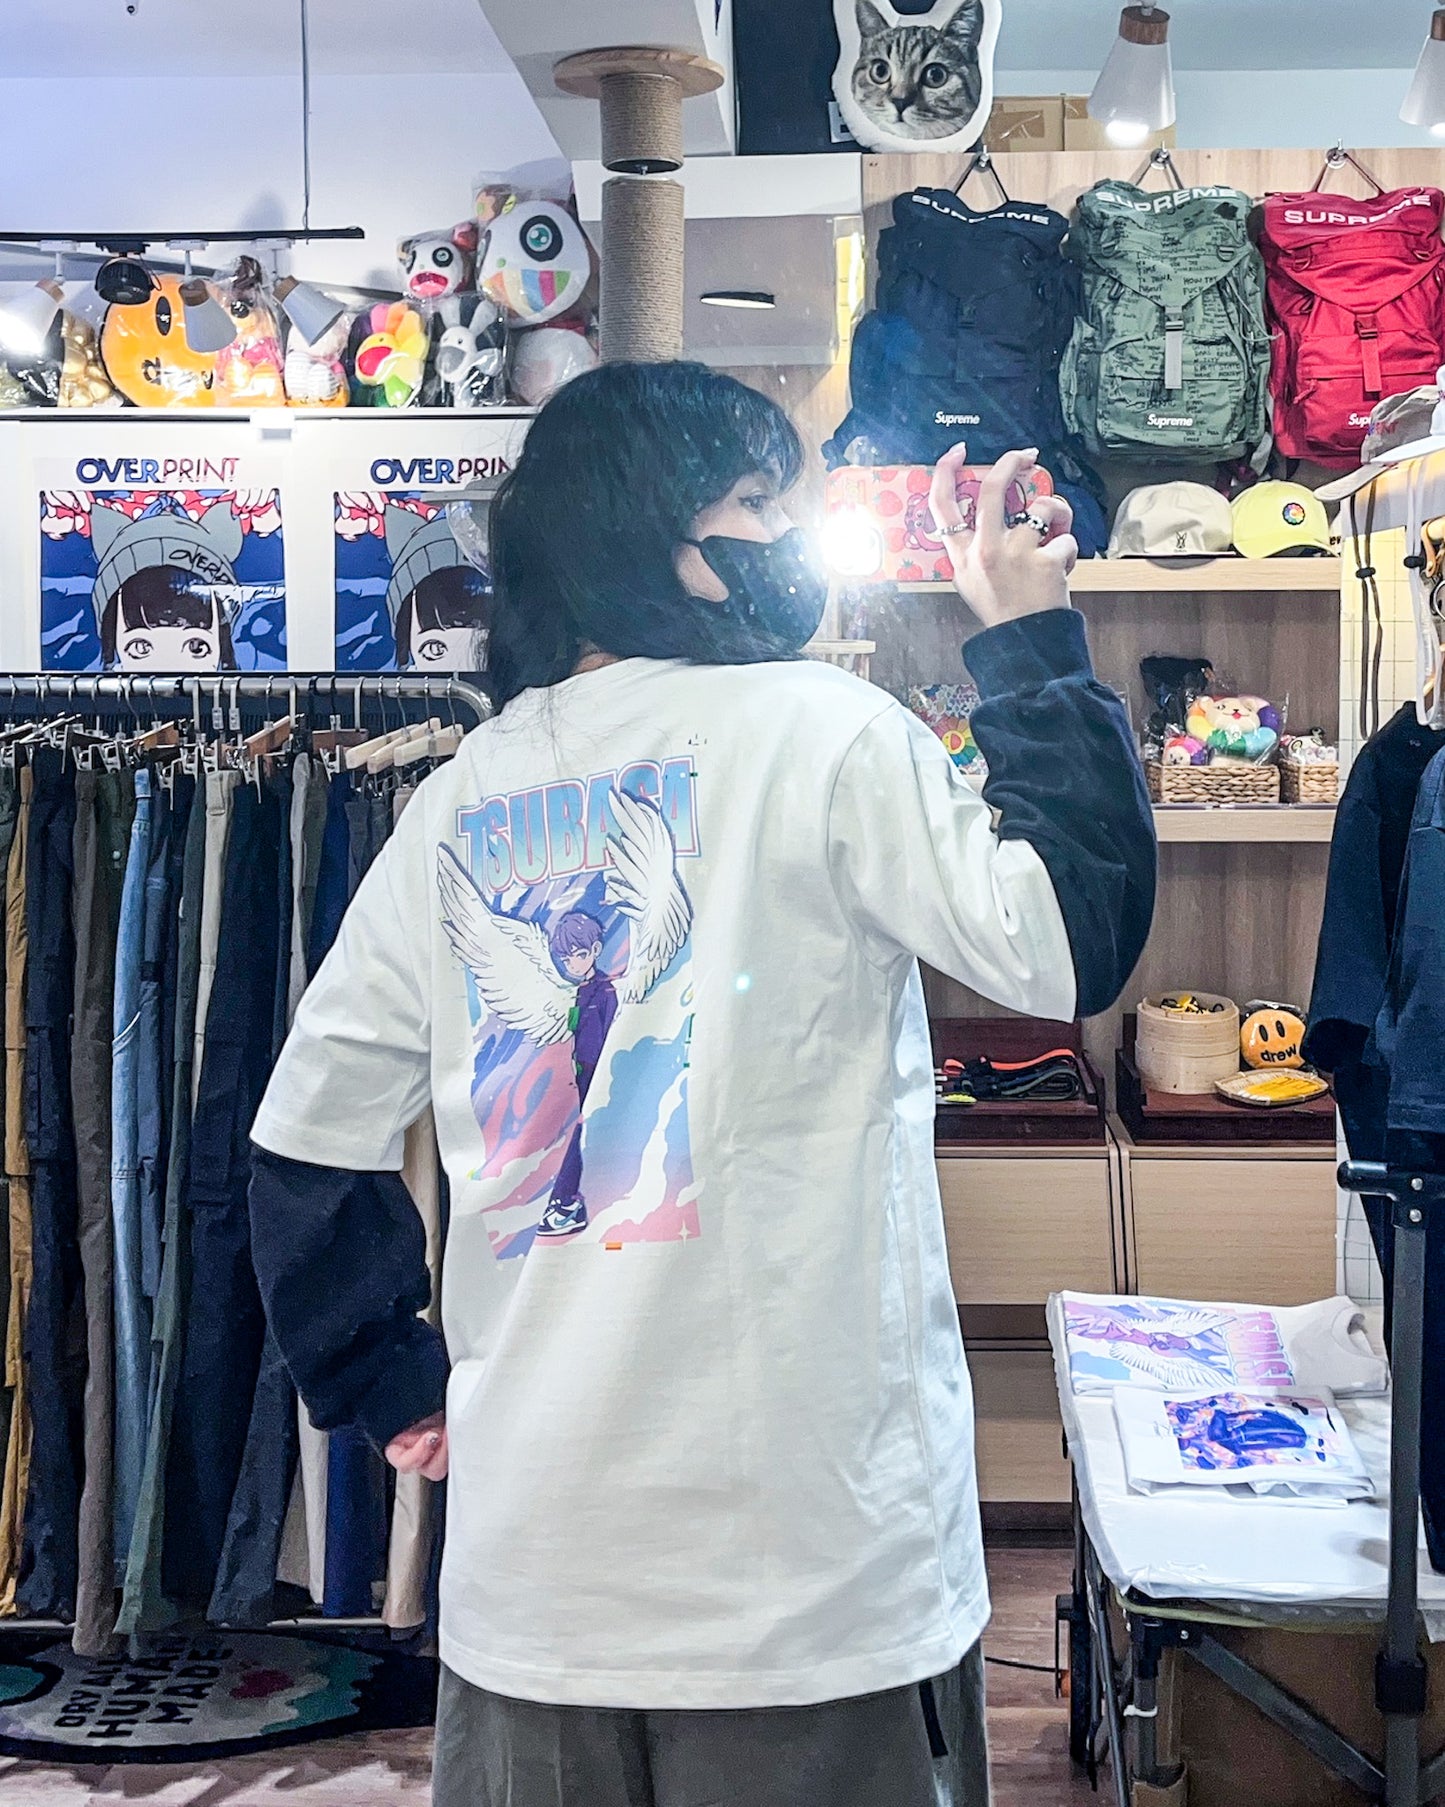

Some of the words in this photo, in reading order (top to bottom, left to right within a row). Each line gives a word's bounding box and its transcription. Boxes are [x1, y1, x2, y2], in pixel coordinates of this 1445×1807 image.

[1096, 188, 1238, 214] SUPREME
[935, 411, 980, 427] Supreme
[1147, 414, 1193, 428] Supreme
[1348, 413, 1371, 428] Supr
[76, 458, 240, 484] OVERPRINT
[370, 457, 511, 484] OVERPRI
[1261, 1044, 1297, 1063] drew
[87, 1640, 190, 1738] HUMAN
[146, 1645, 233, 1724] MADE
[54, 1690, 101, 1727] DRY
